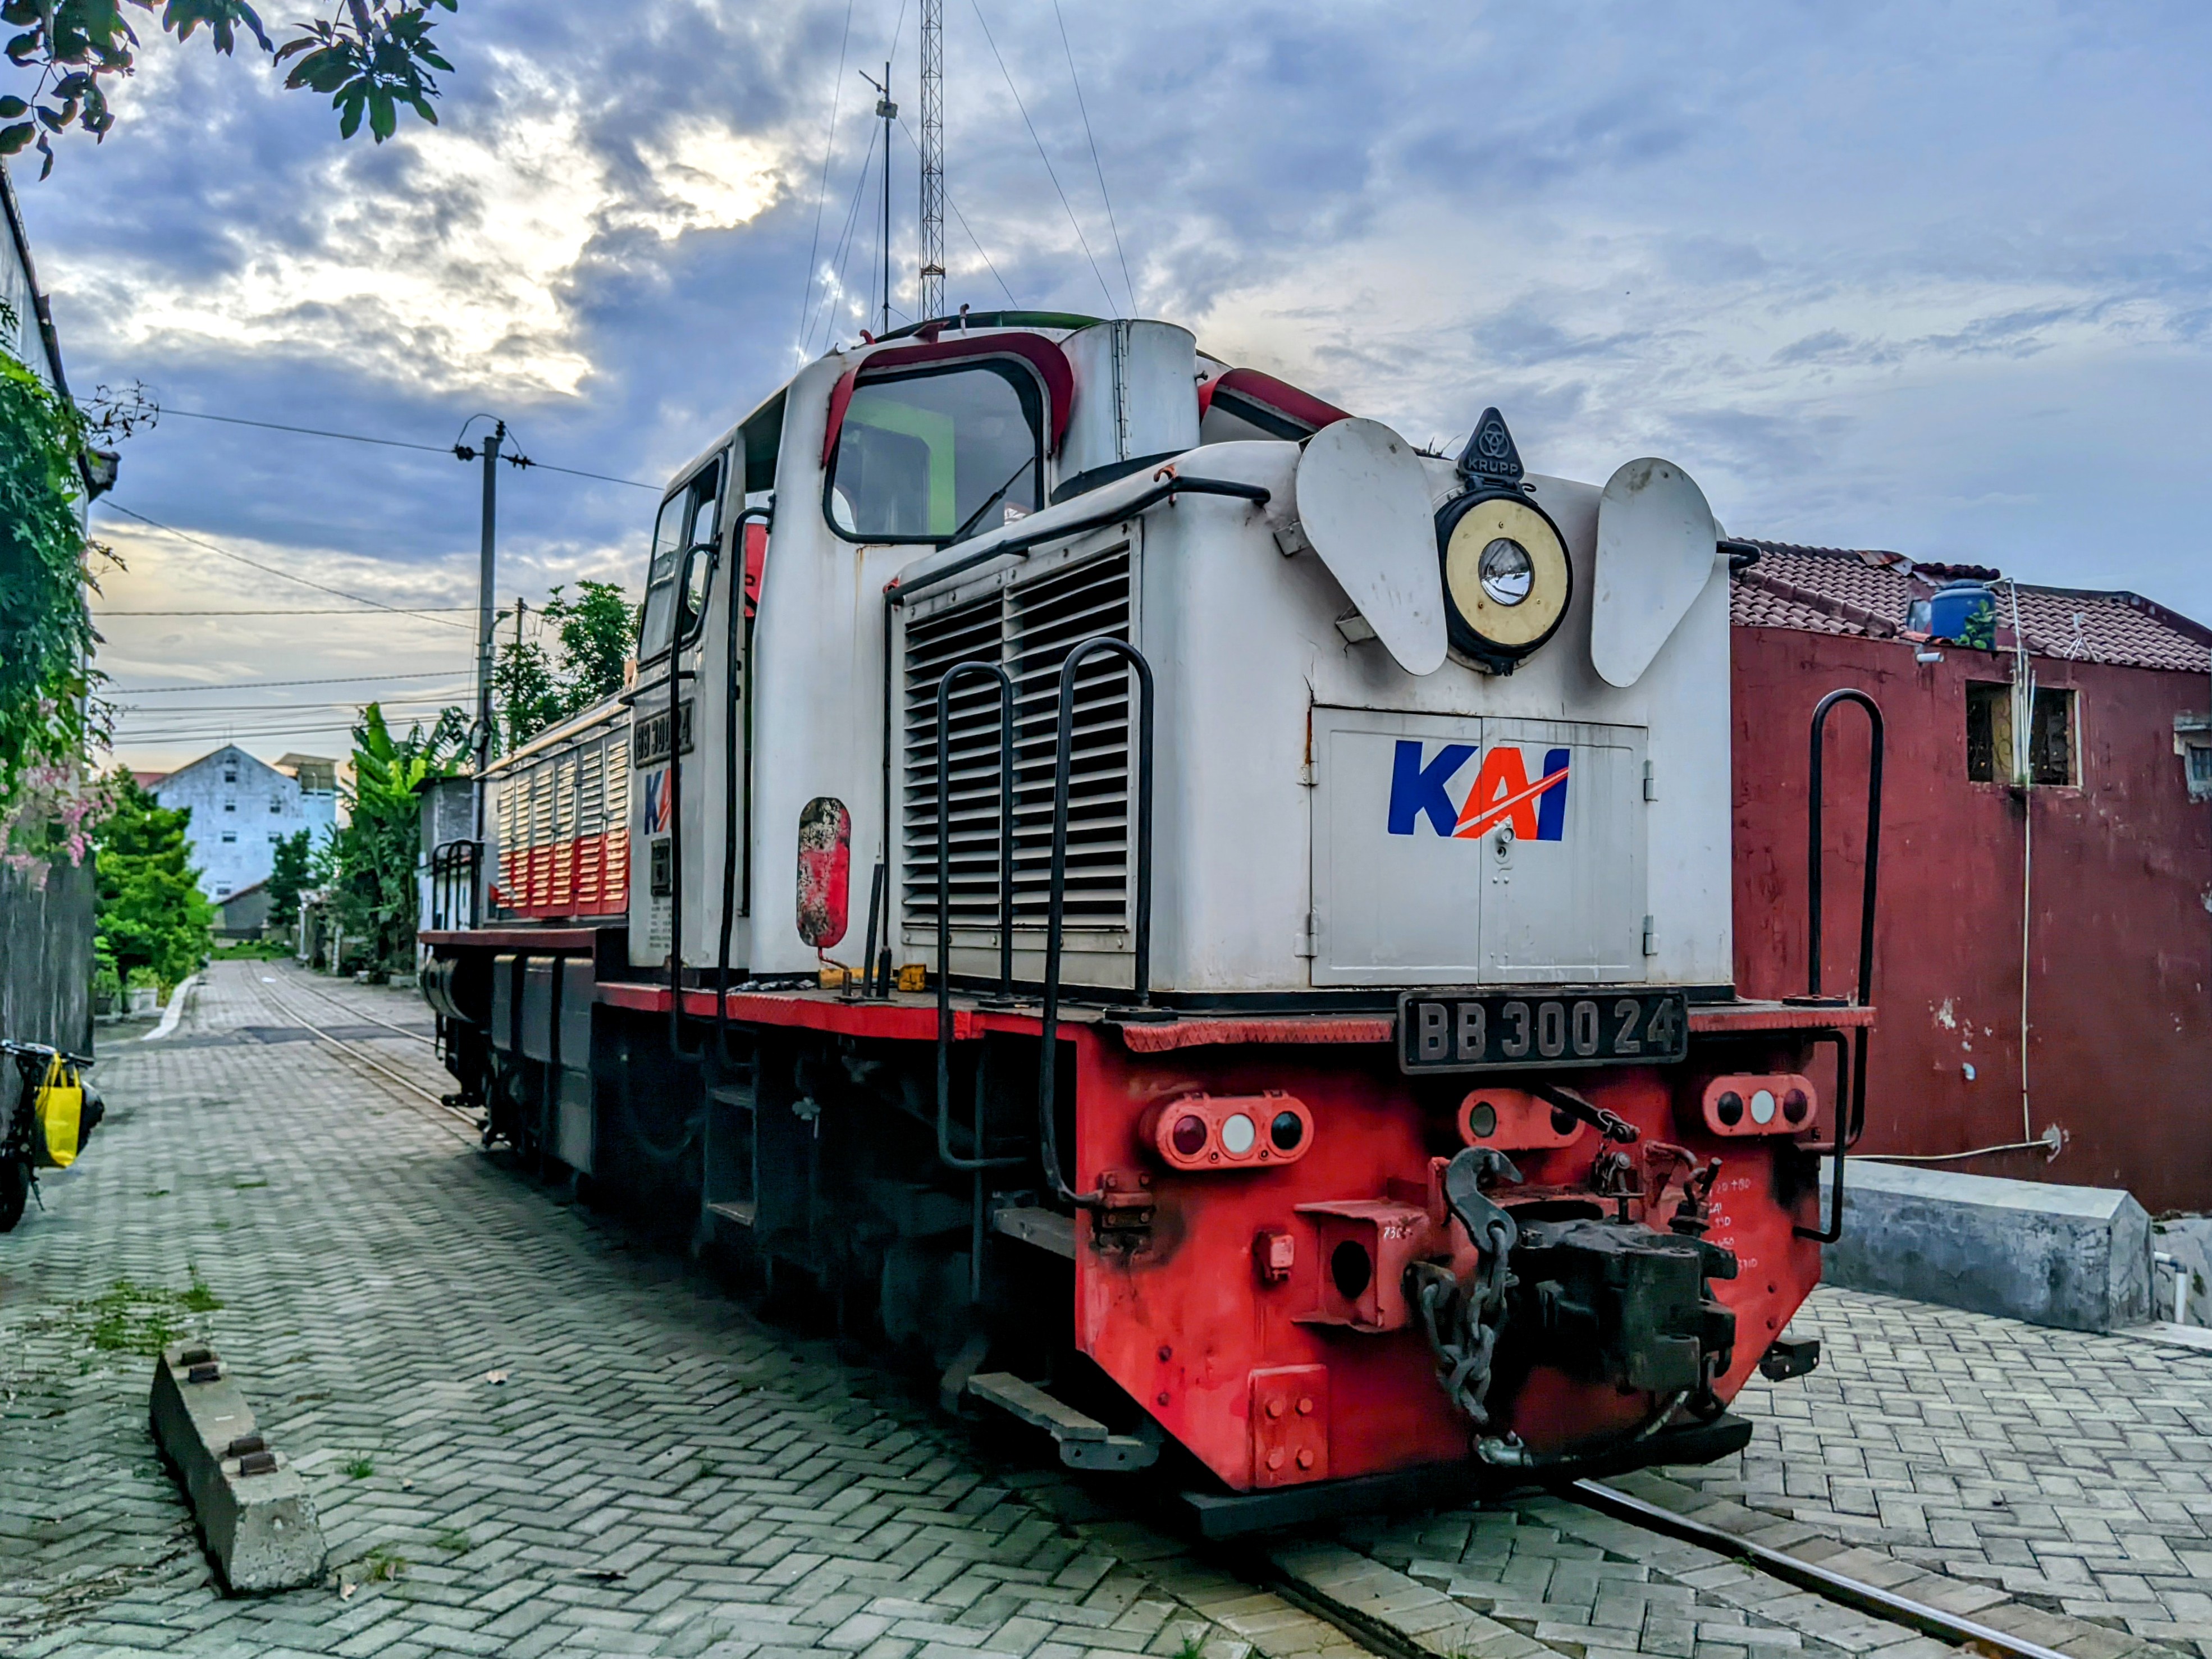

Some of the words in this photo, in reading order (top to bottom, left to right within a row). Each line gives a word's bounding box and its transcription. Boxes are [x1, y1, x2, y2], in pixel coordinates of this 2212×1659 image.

[1468, 458, 1519, 475] KRUPP
[644, 762, 683, 835] KA
[1387, 740, 1571, 841] KAI
[1418, 1002, 1486, 1061] BB
[1502, 1000, 1598, 1057] 300
[1614, 998, 1676, 1054] 24
